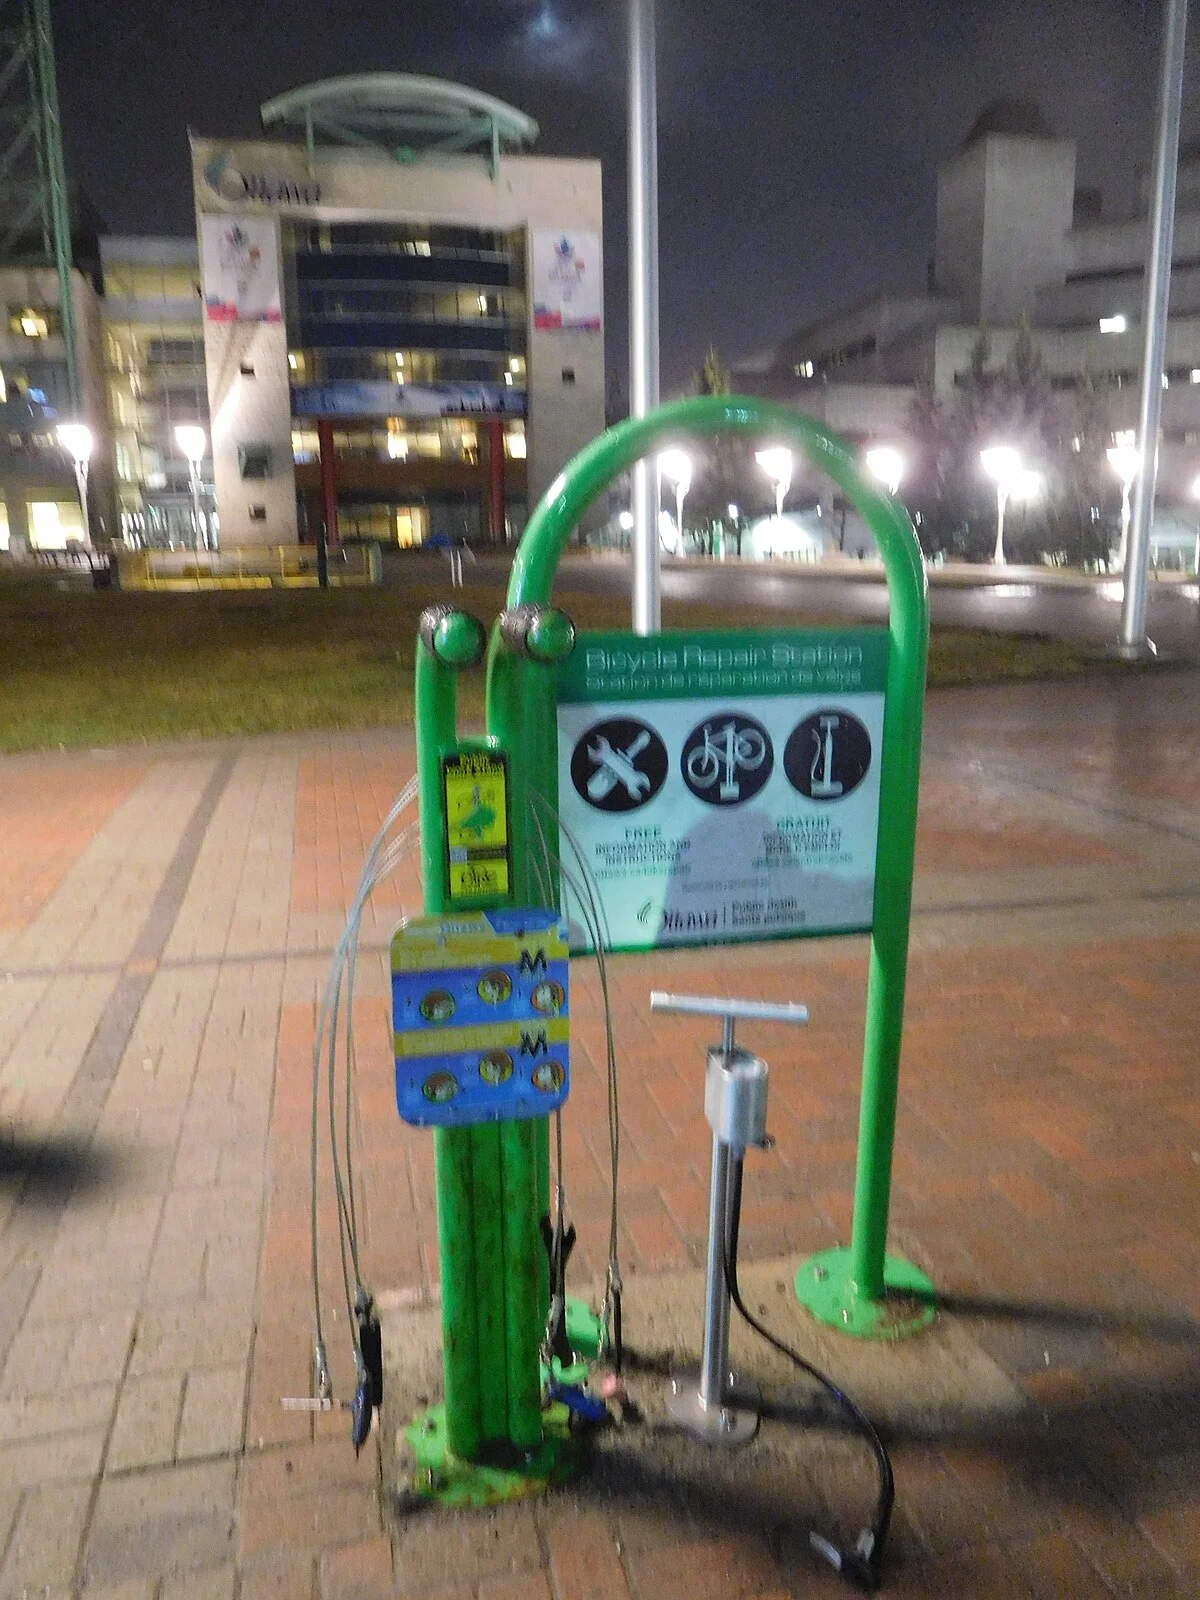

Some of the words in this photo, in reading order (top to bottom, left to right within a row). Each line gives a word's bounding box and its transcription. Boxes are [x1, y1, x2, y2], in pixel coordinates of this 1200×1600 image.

[586, 646, 678, 674] Bicycle
[684, 644, 766, 670] Repair
[772, 642, 863, 666] Station
